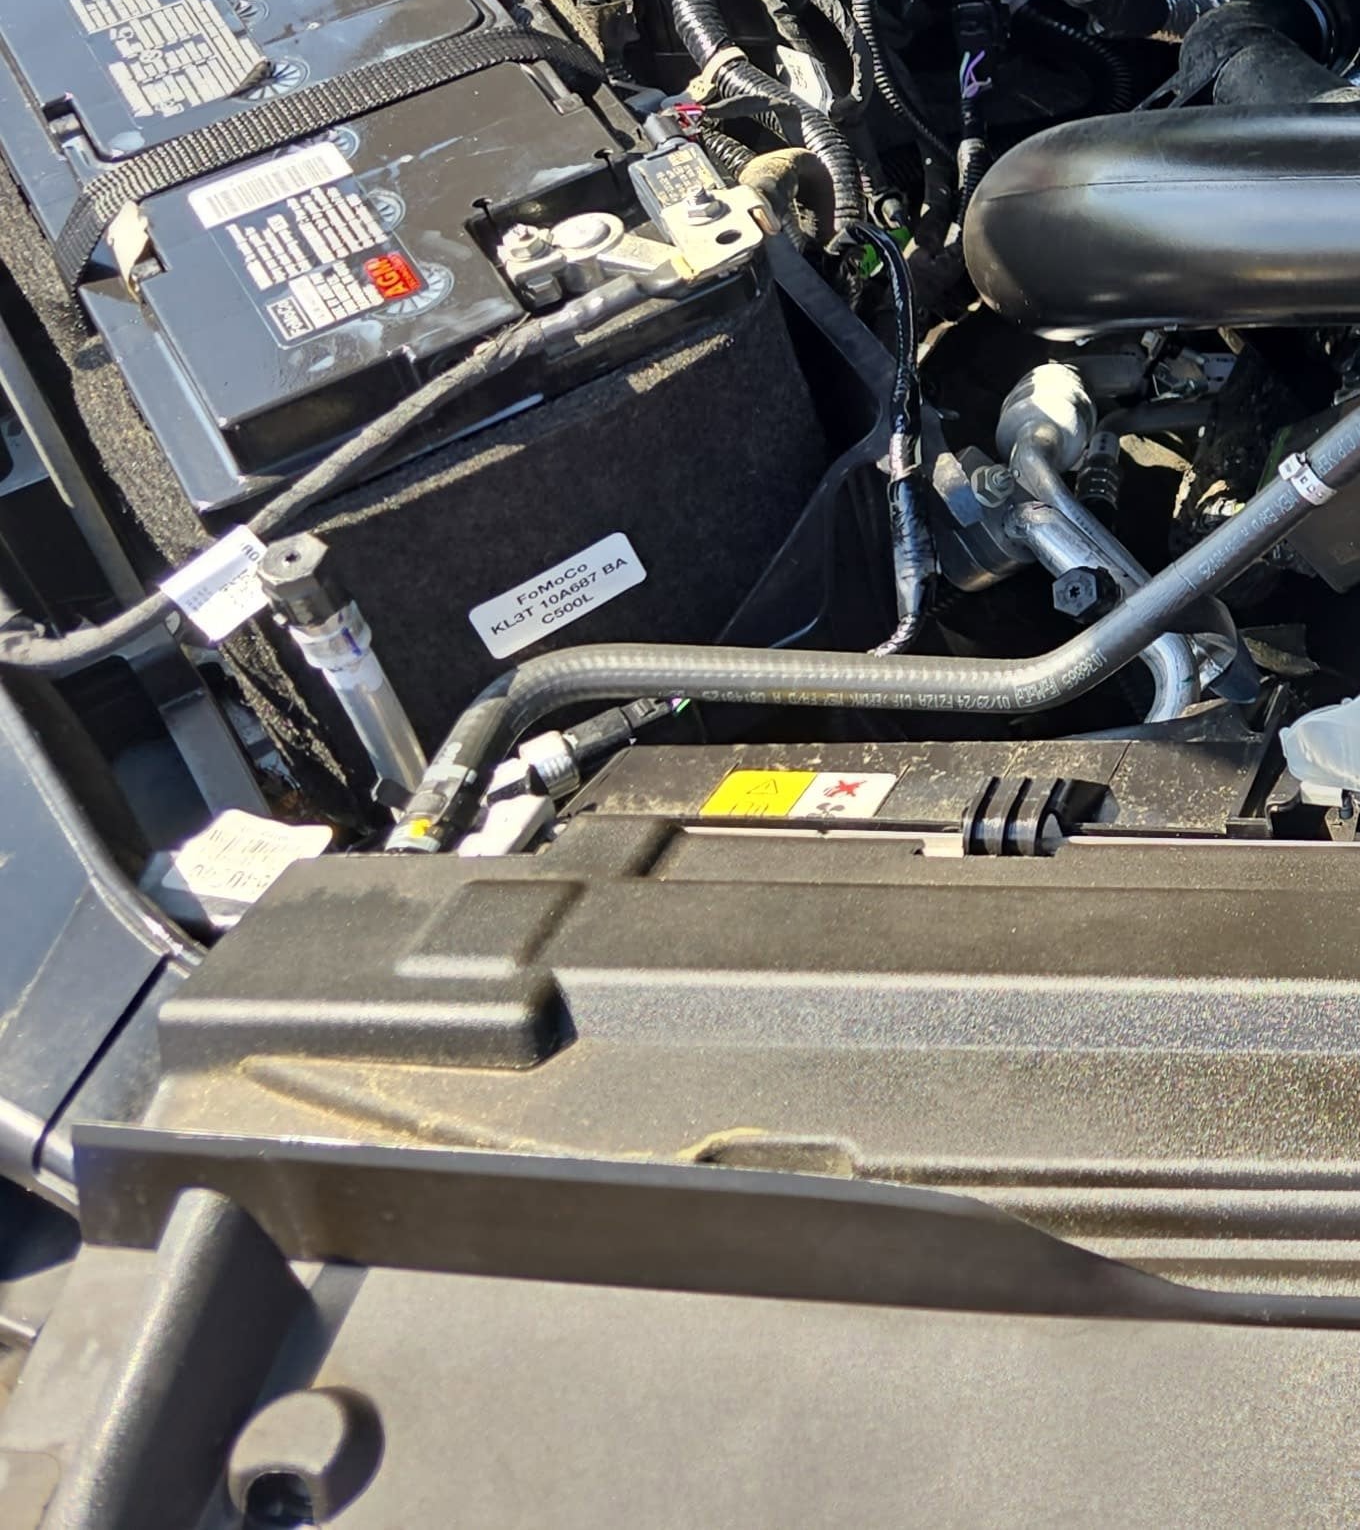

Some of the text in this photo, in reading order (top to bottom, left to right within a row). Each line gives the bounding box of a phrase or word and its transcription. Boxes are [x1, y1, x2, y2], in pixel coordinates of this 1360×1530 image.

[367, 257, 409, 299] AGM
[491, 558, 628, 635] KL3T 10A687 BA
[516, 564, 588, 605] FoMoCo
[541, 593, 594, 624] C500L
